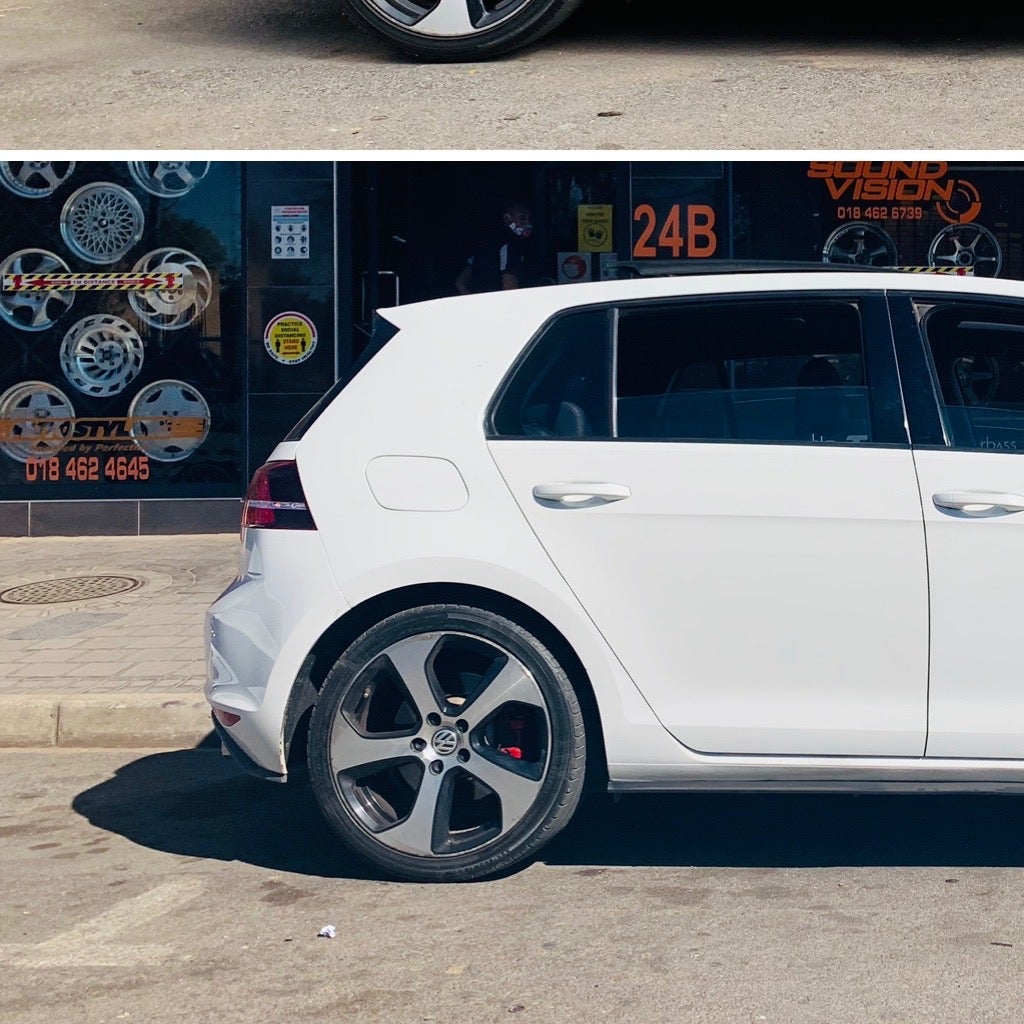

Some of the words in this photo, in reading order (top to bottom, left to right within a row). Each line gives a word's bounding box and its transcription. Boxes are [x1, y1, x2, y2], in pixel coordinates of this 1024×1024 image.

[807, 161, 948, 179] SOUND
[824, 178, 954, 201] VISION
[837, 206, 861, 219] 018
[864, 206, 888, 219] 462
[891, 206, 922, 220] 6739
[633, 204, 717, 258] 24B
[80, 445, 91, 454] by
[26, 457, 60, 482] 018
[65, 456, 99, 481] 462
[105, 456, 150, 481] 4645
